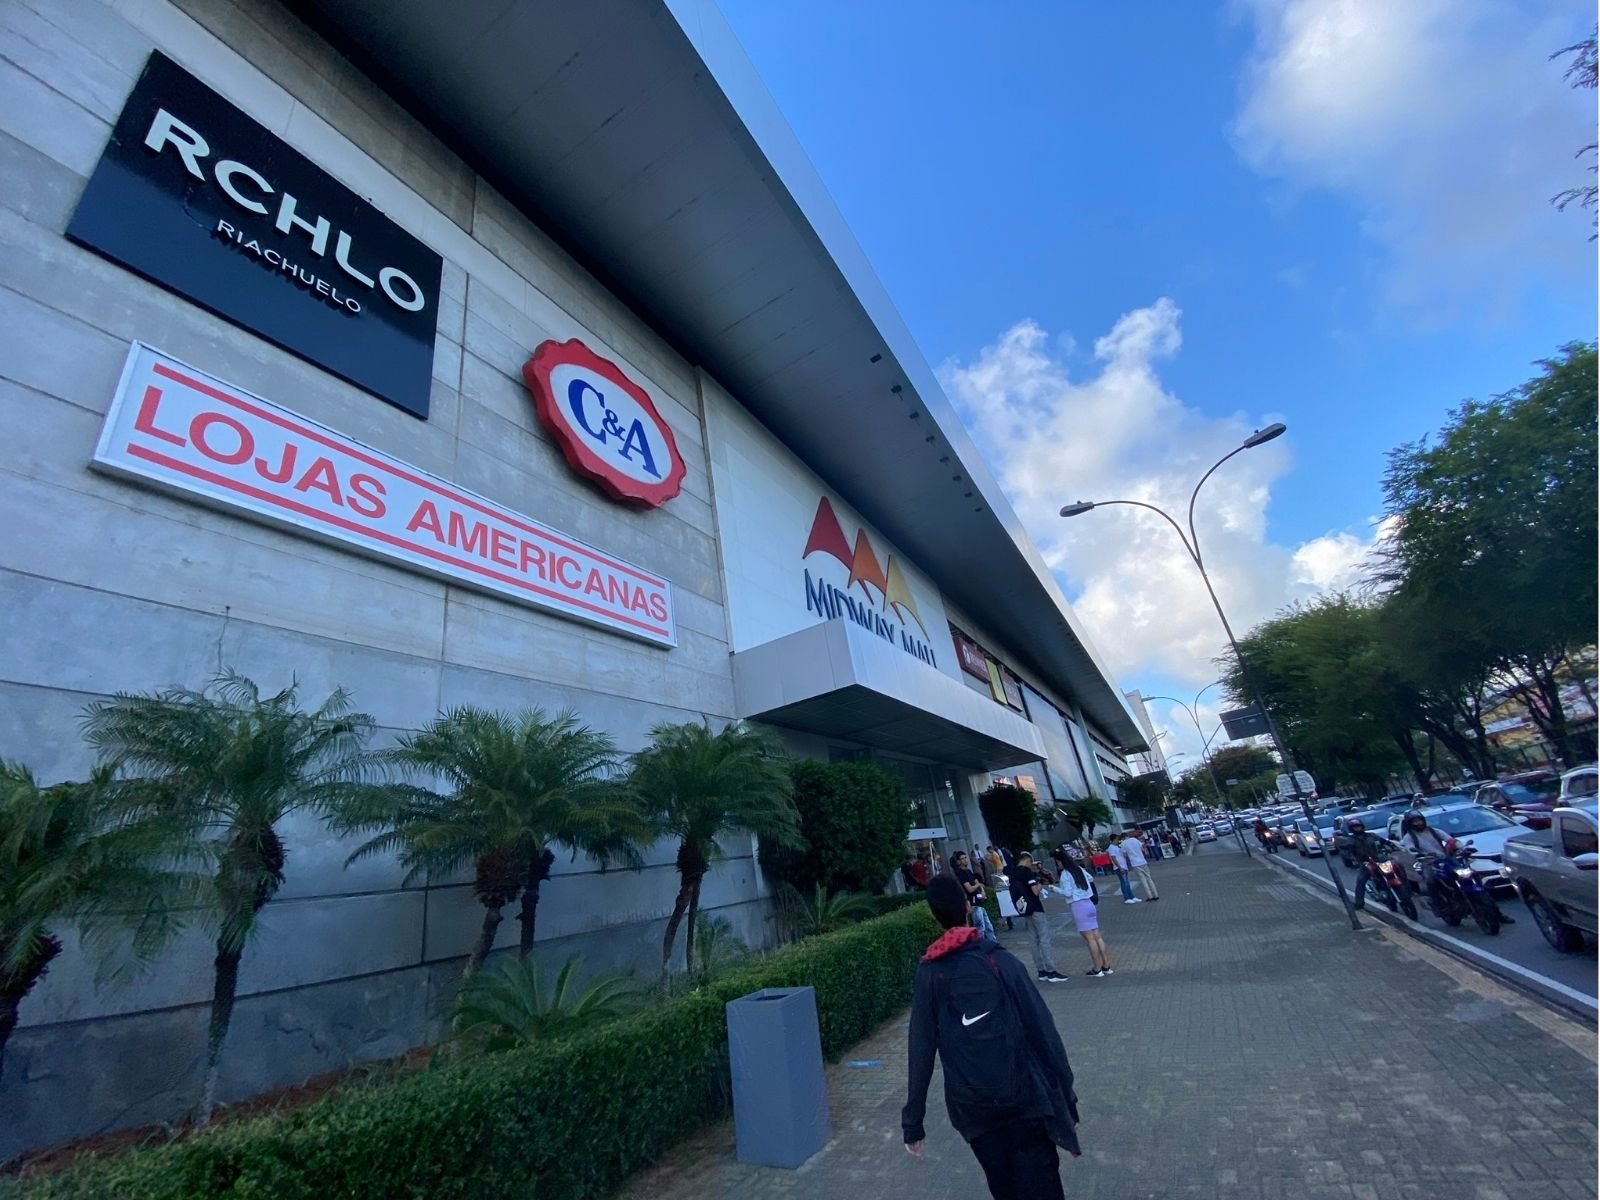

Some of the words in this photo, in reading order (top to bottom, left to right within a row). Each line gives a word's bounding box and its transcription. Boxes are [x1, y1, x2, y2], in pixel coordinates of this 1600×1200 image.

[144, 108, 425, 312] RCHLO
[217, 219, 361, 313] RIACHUELO
[134, 385, 387, 519] LOJAS
[405, 499, 669, 623] AMERICANAS
[568, 378, 662, 480] C&A
